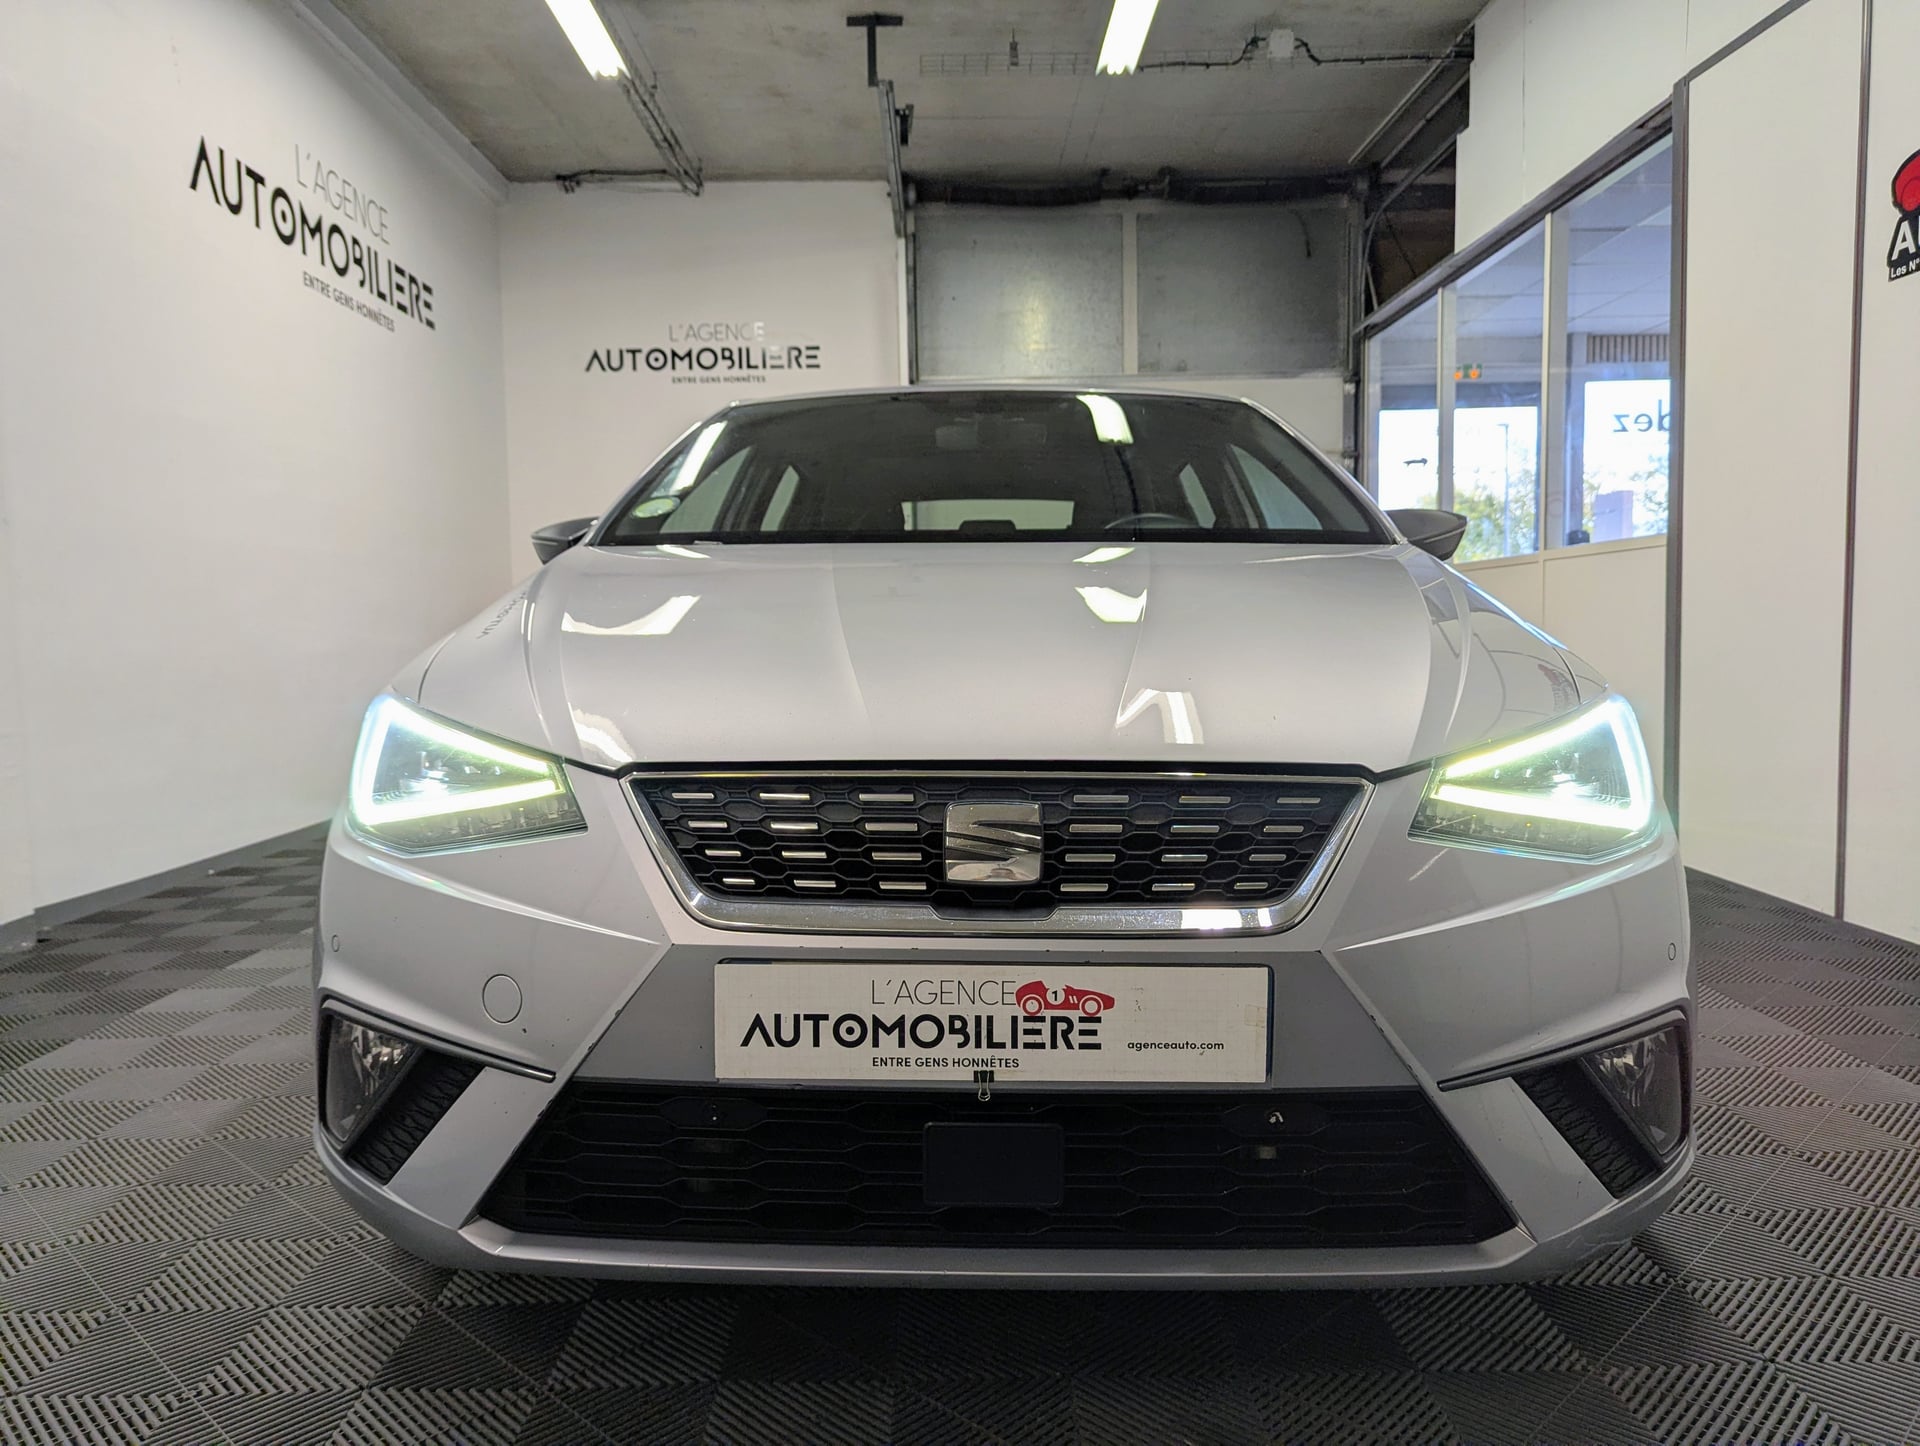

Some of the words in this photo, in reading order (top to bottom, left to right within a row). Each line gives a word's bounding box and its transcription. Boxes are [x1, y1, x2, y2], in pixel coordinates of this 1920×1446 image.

[295, 143, 390, 245] L'AGENCE
[1890, 265, 1907, 279] Les
[303, 271, 332, 299] ENTRE
[333, 287, 355, 311] GENS
[356, 300, 396, 333] HONNÊTES
[668, 321, 765, 342] L'AGENCE
[671, 375, 697, 384] ENTRE
[699, 375, 721, 384] GENS
[871, 979, 1017, 1006] L'AGENCE
[1051, 989, 1058, 1002] 1
[1127, 1040, 1224, 1052] agenceauto.com
[872, 1056, 911, 1068] ENTRE
[915, 1056, 949, 1068] GENS
[952, 1055, 1019, 1069] HONNÊTES
